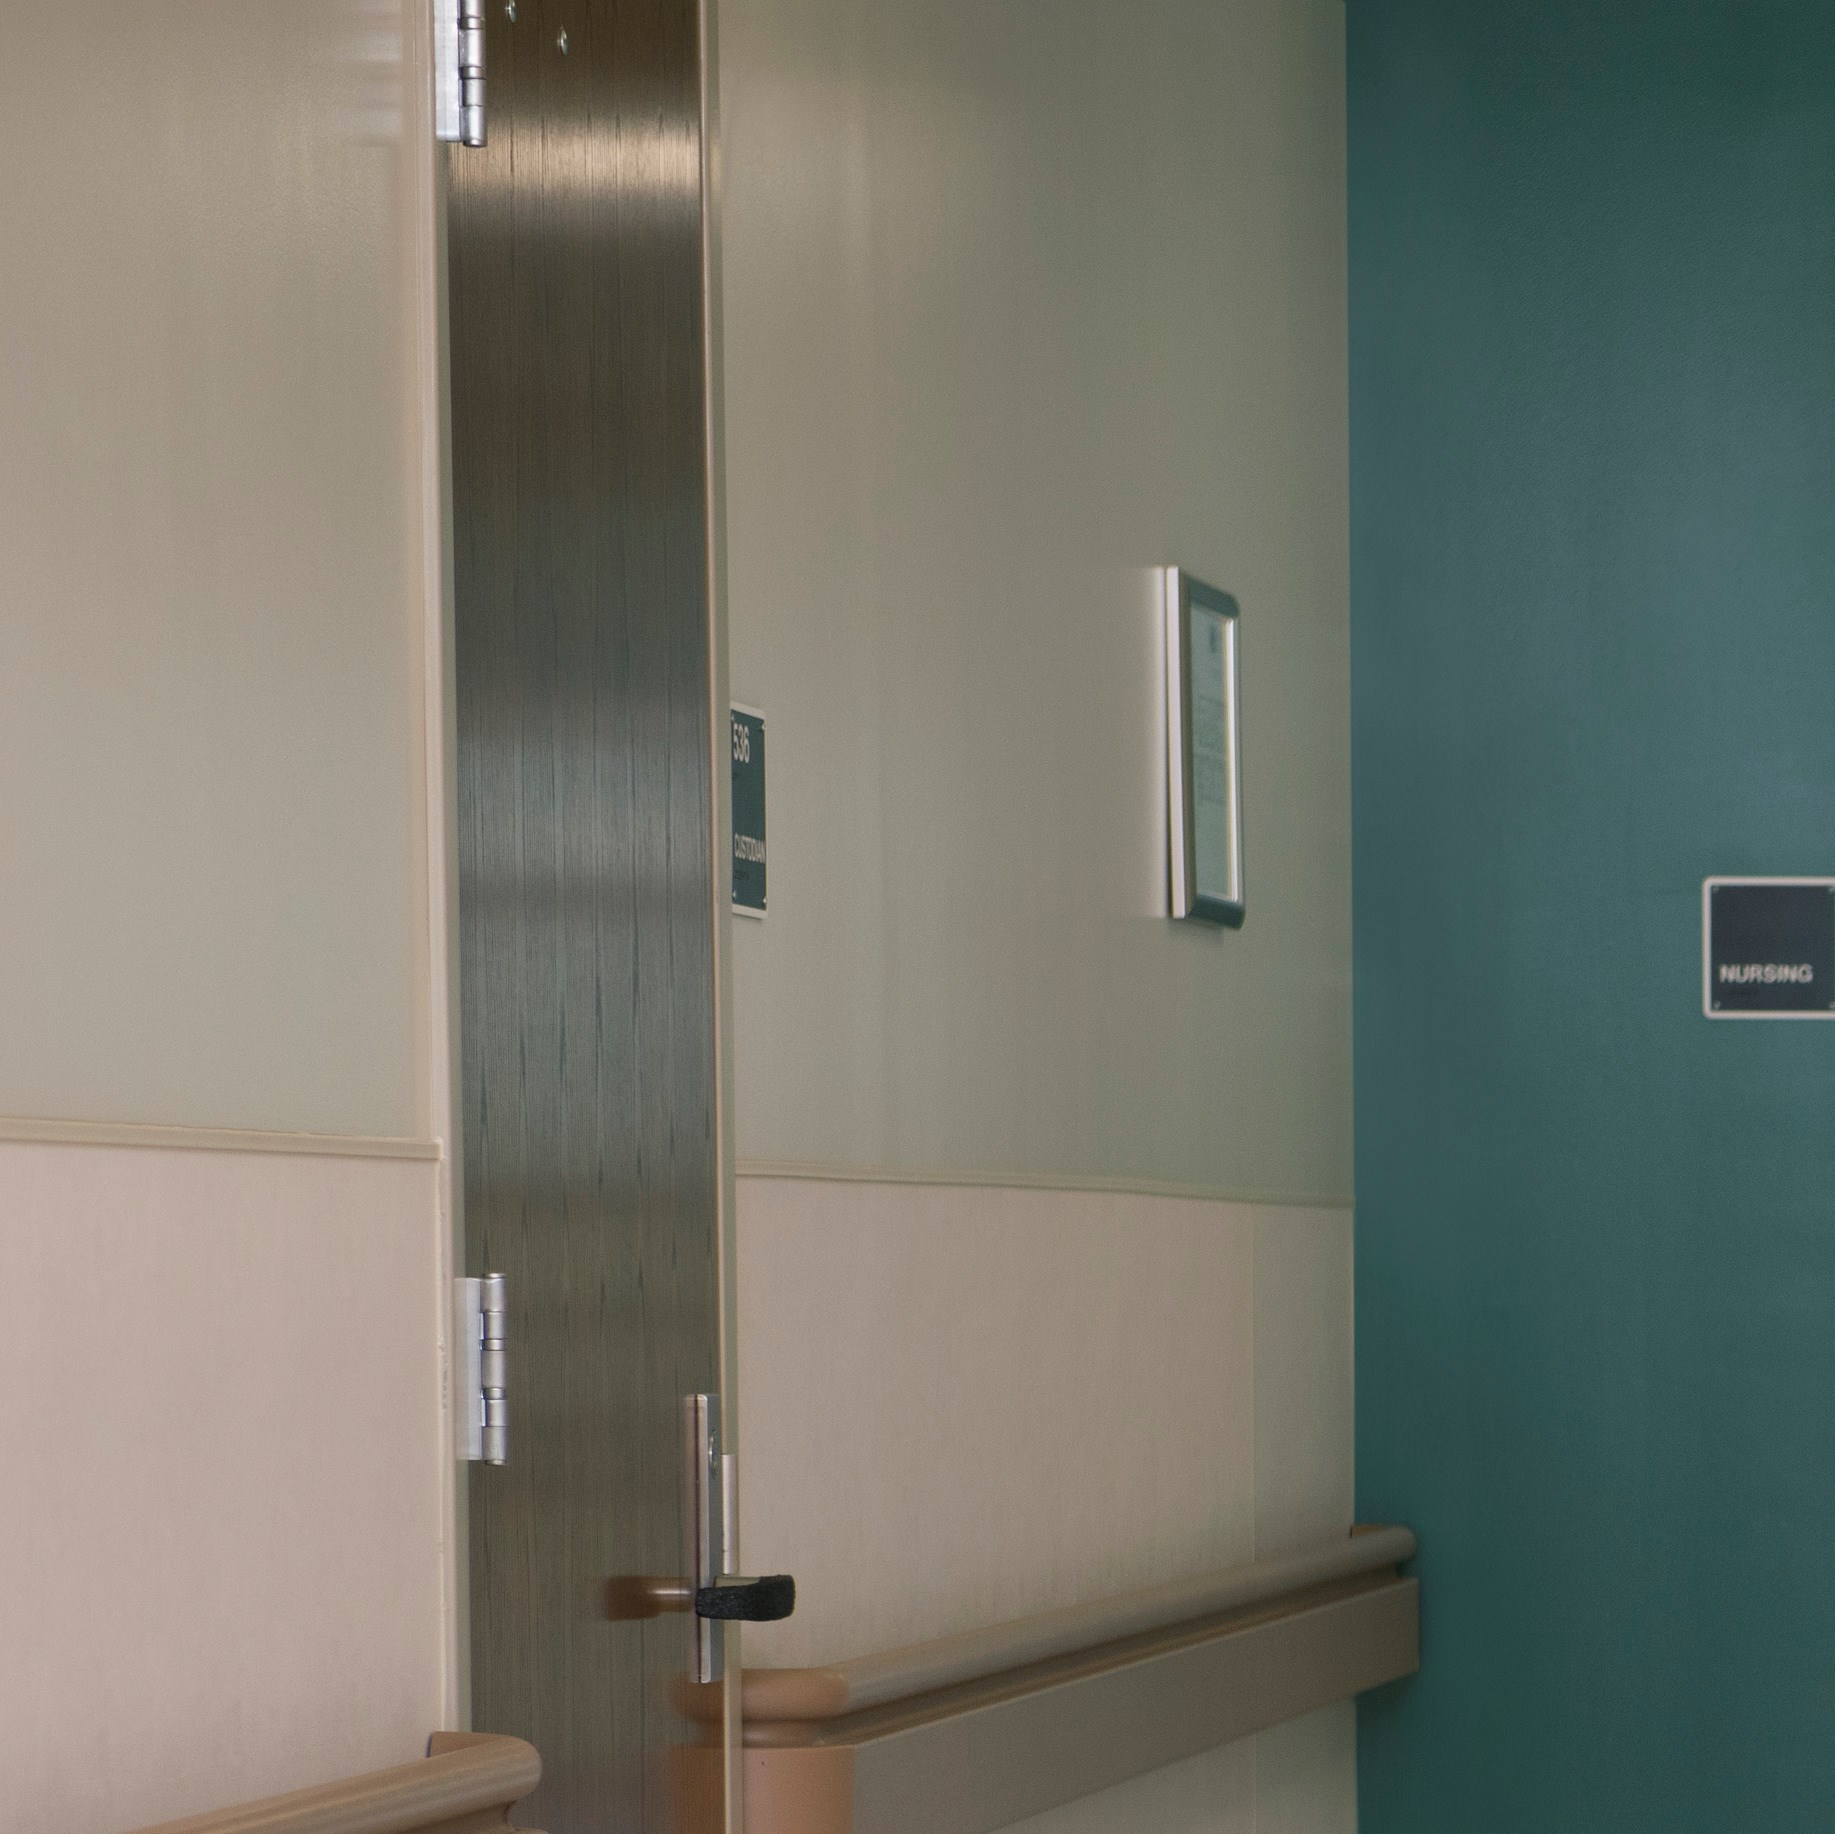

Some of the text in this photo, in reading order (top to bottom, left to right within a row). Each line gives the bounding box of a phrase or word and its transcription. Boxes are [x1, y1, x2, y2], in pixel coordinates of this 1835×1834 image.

[732, 723, 750, 763] 536
[734, 834, 766, 864] CUSTODIAN
[1719, 963, 1814, 983] NURSING
